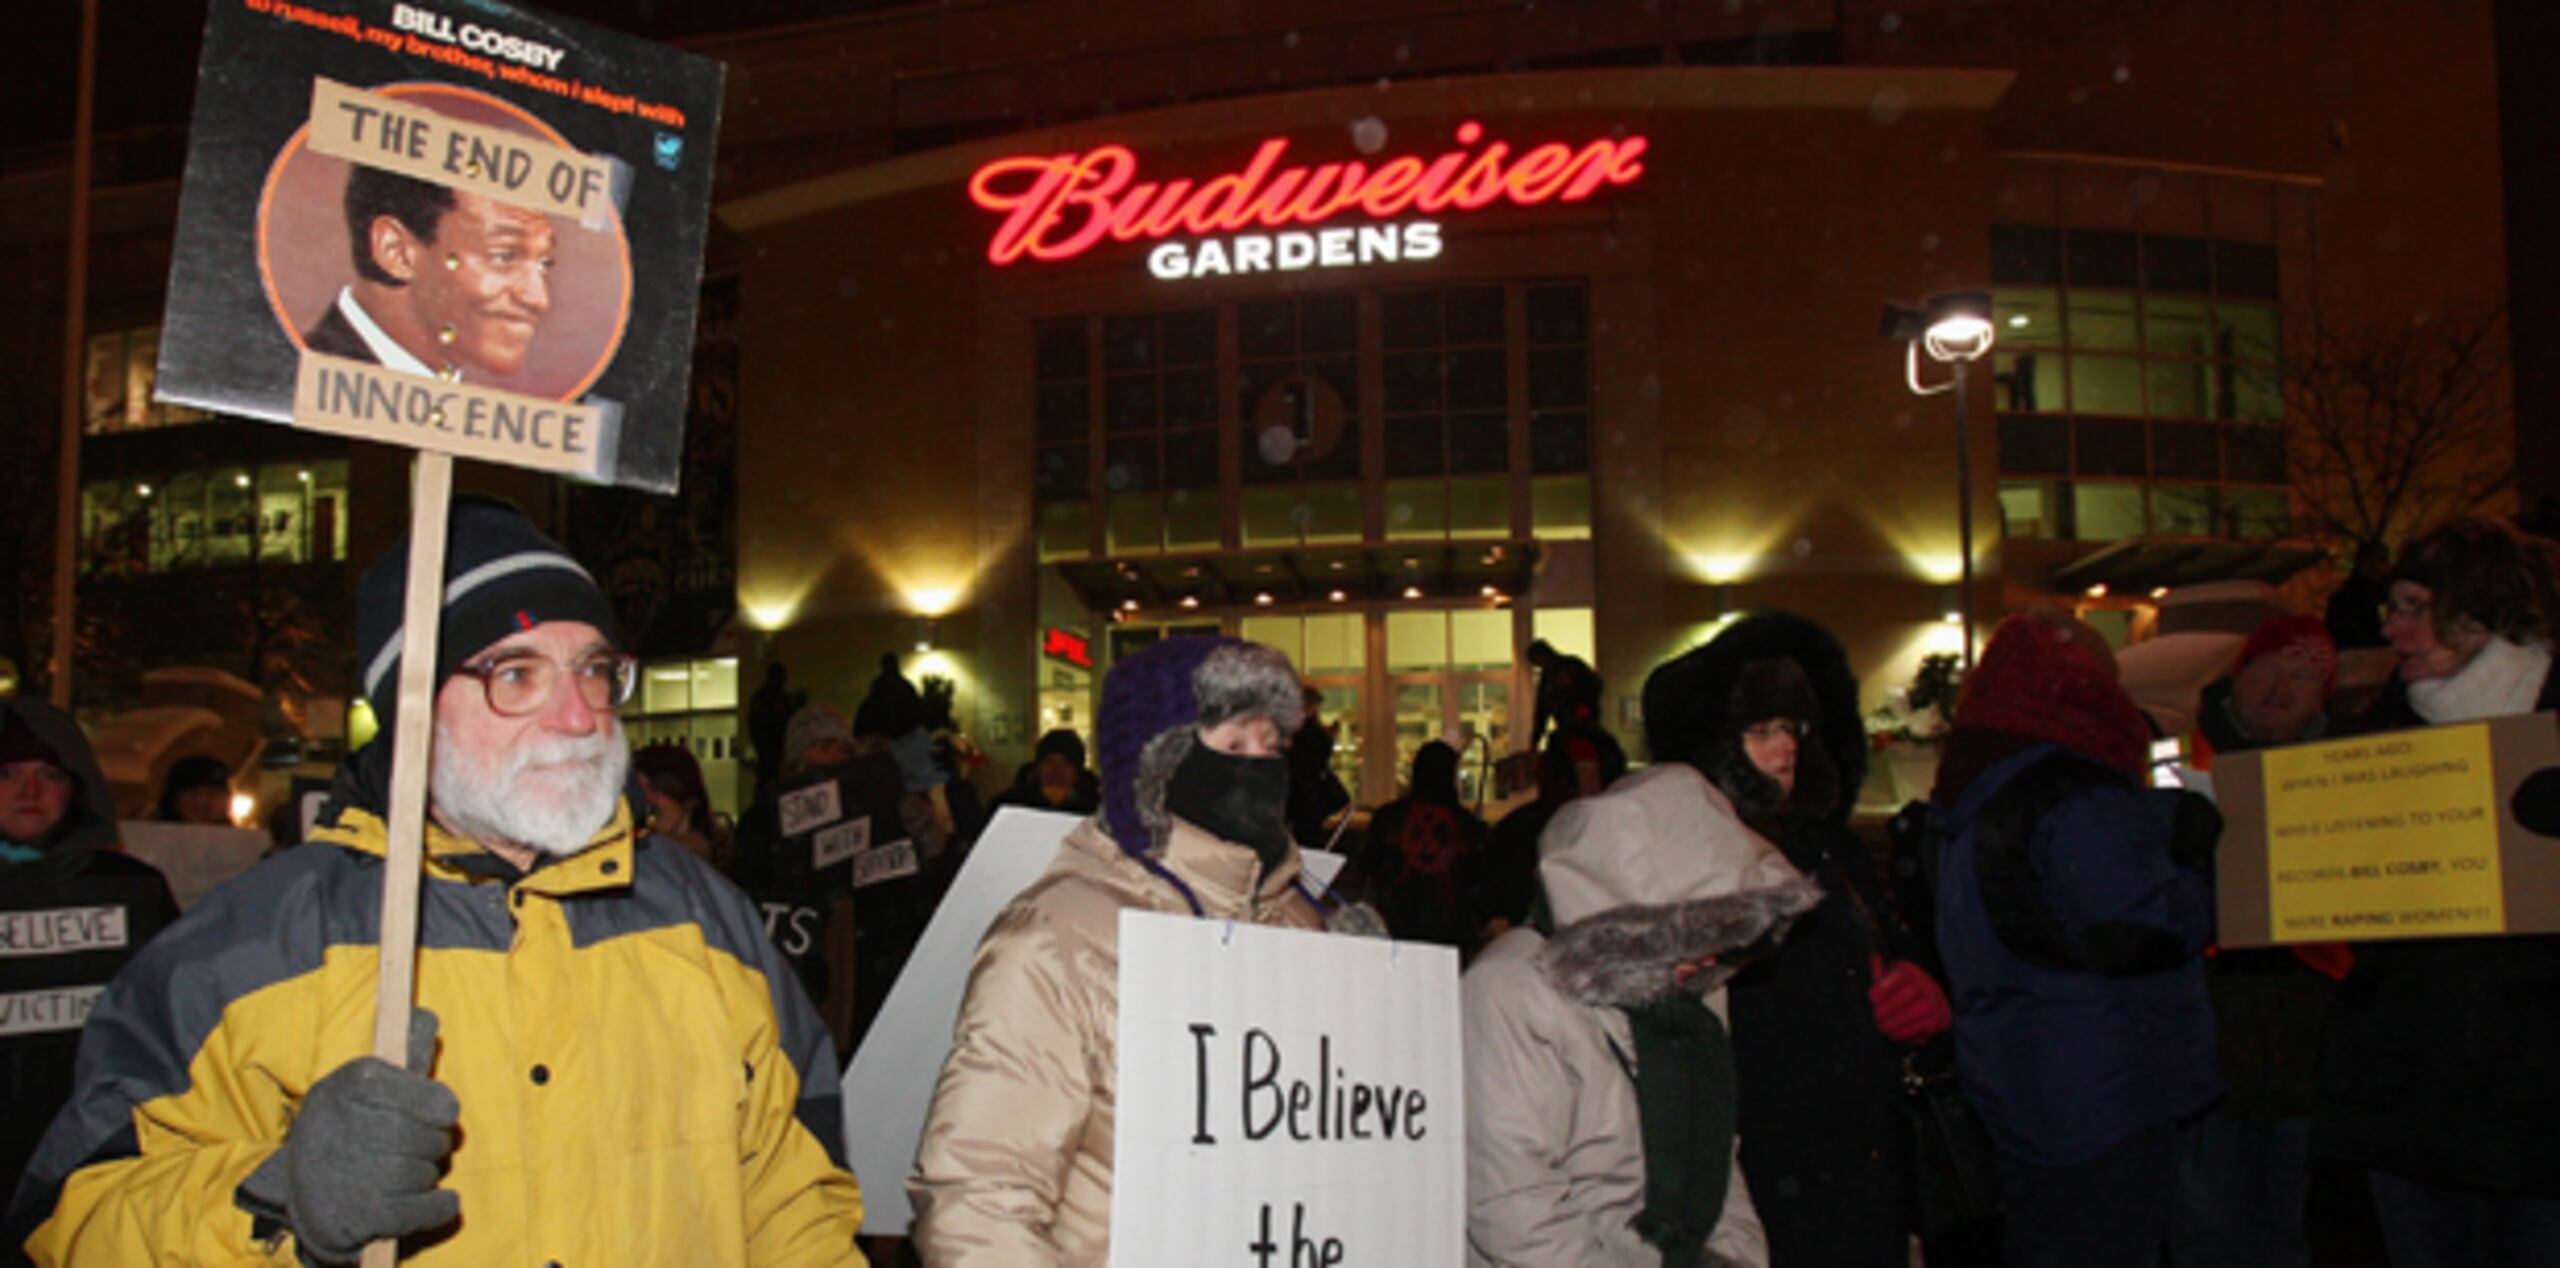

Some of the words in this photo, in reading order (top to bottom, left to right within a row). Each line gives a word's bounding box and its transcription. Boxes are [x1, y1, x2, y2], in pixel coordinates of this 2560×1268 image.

[391, 3, 457, 43] BILL
[458, 23, 565, 71] COSBY
[365, 26, 403, 53] my
[406, 33, 495, 80] brother,
[500, 63, 569, 97] whom
[571, 79, 582, 99] i
[582, 85, 635, 115] slept
[637, 101, 686, 129] with
[339, 102, 429, 160] THE
[444, 131, 532, 190] END
[547, 161, 605, 209] OF
[967, 121, 1648, 267] Budweiser
[1148, 221, 1442, 280] GARDENS
[317, 368, 587, 453] INNOCENCE
[2408, 809, 2433, 826] TO
[2435, 806, 2485, 824] YOUR
[2349, 863, 2381, 880] BILL
[2448, 857, 2488, 873] YOU
[1188, 1023, 1217, 1145] I
[1241, 1027, 1427, 1142] Believe
[1249, 1202, 1344, 1268] the
